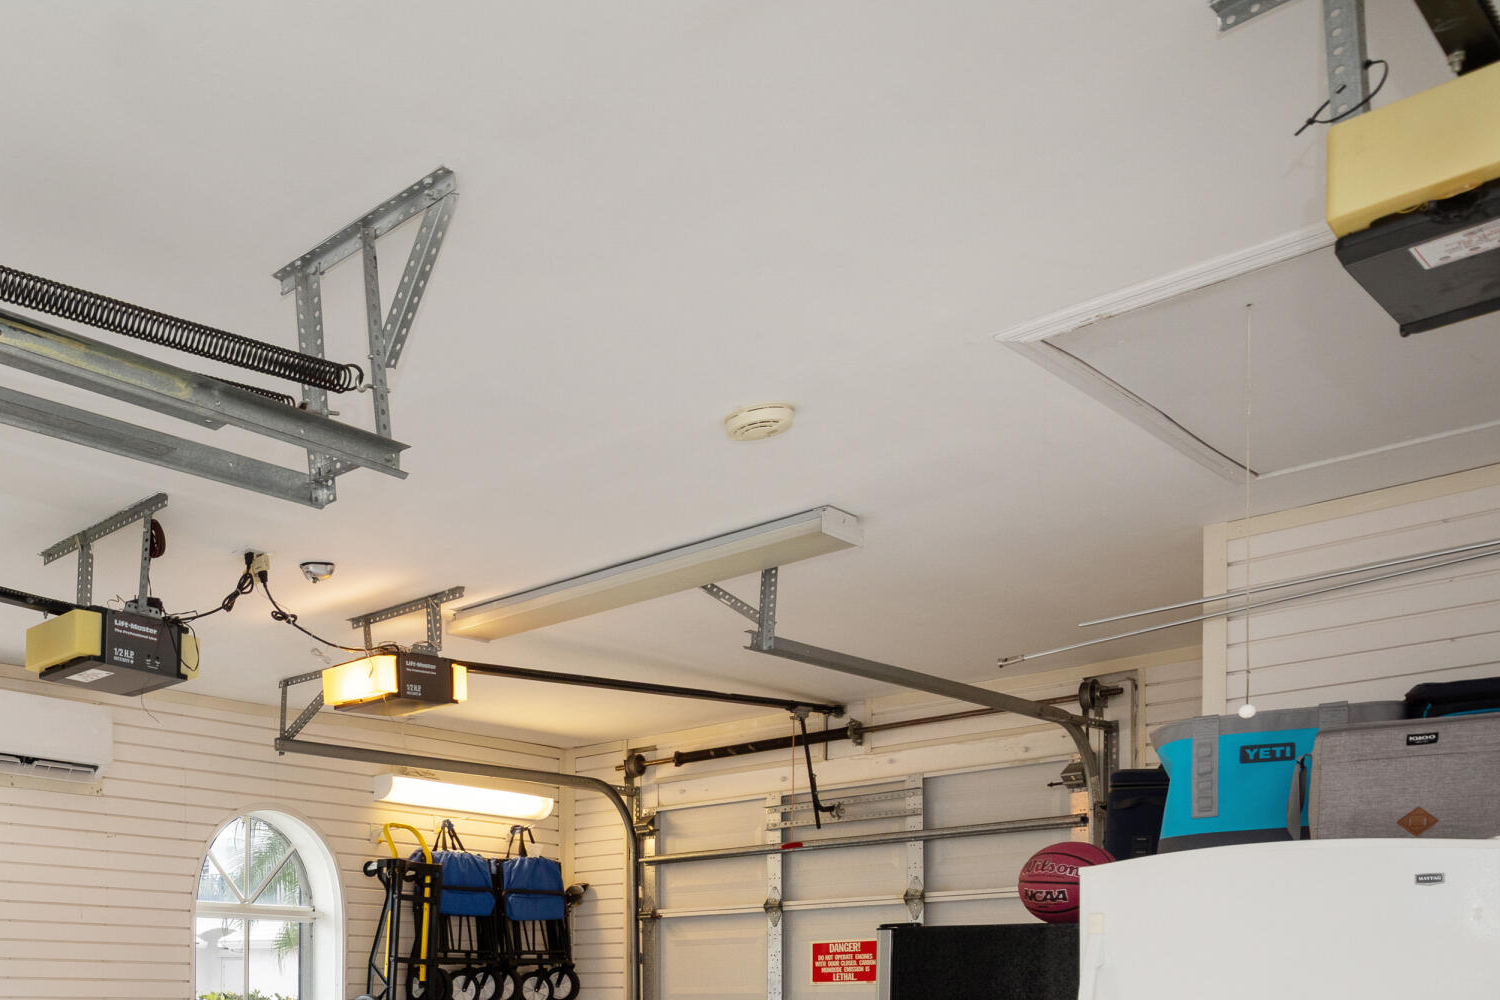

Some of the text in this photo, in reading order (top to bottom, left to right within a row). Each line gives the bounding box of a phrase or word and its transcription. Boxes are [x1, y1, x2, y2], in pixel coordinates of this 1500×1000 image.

[114, 619, 158, 635] Lift-Master
[1244, 746, 1291, 760] YETI
[1024, 888, 1069, 904] NCAA
[829, 942, 861, 953] DANGER!
